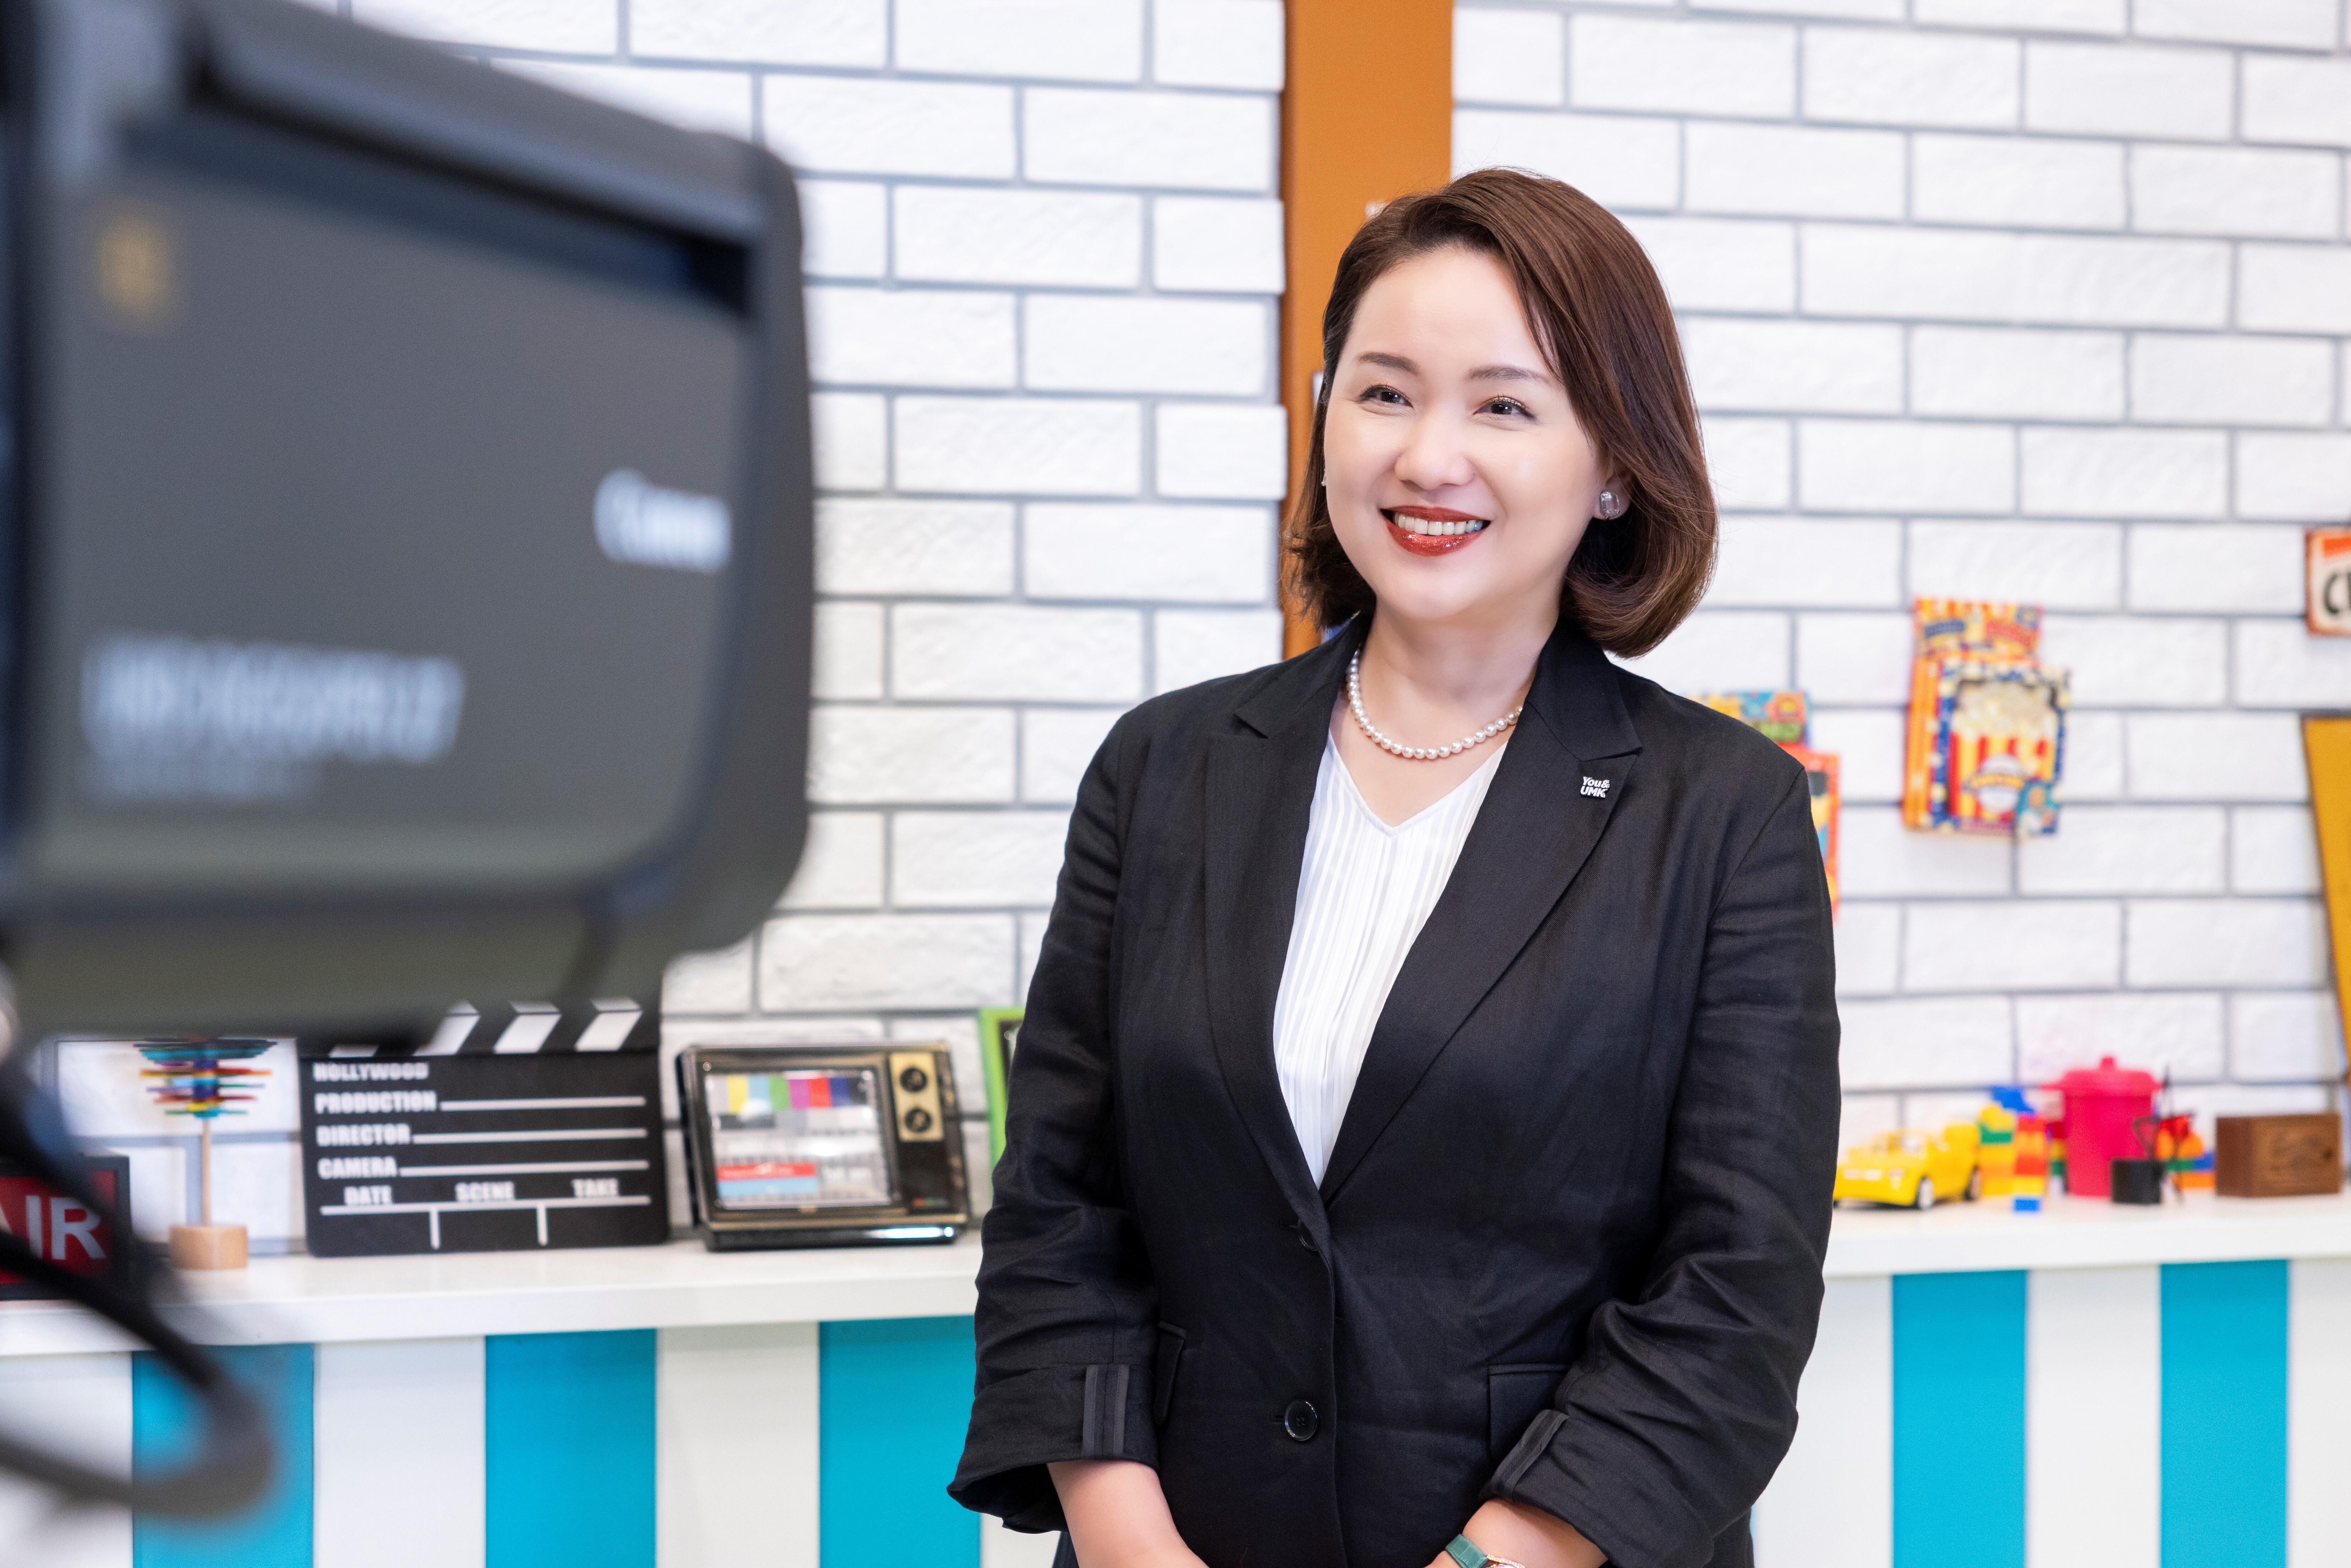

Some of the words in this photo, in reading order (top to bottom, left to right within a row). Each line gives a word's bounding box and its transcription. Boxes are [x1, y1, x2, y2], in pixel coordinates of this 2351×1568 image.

[1580, 785, 1608, 798] UMK
[1583, 776, 1610, 788] You&
[313, 1062, 429, 1082] HOLLYWOOD
[314, 1090, 437, 1114] PRODUCTION
[316, 1123, 411, 1147] DIRECTOR
[318, 1156, 398, 1179] CAMERA
[344, 1185, 393, 1205] DATE
[455, 1181, 515, 1201] SCENE
[572, 1178, 620, 1197] TAKE
[0, 1195, 106, 1261] IR
